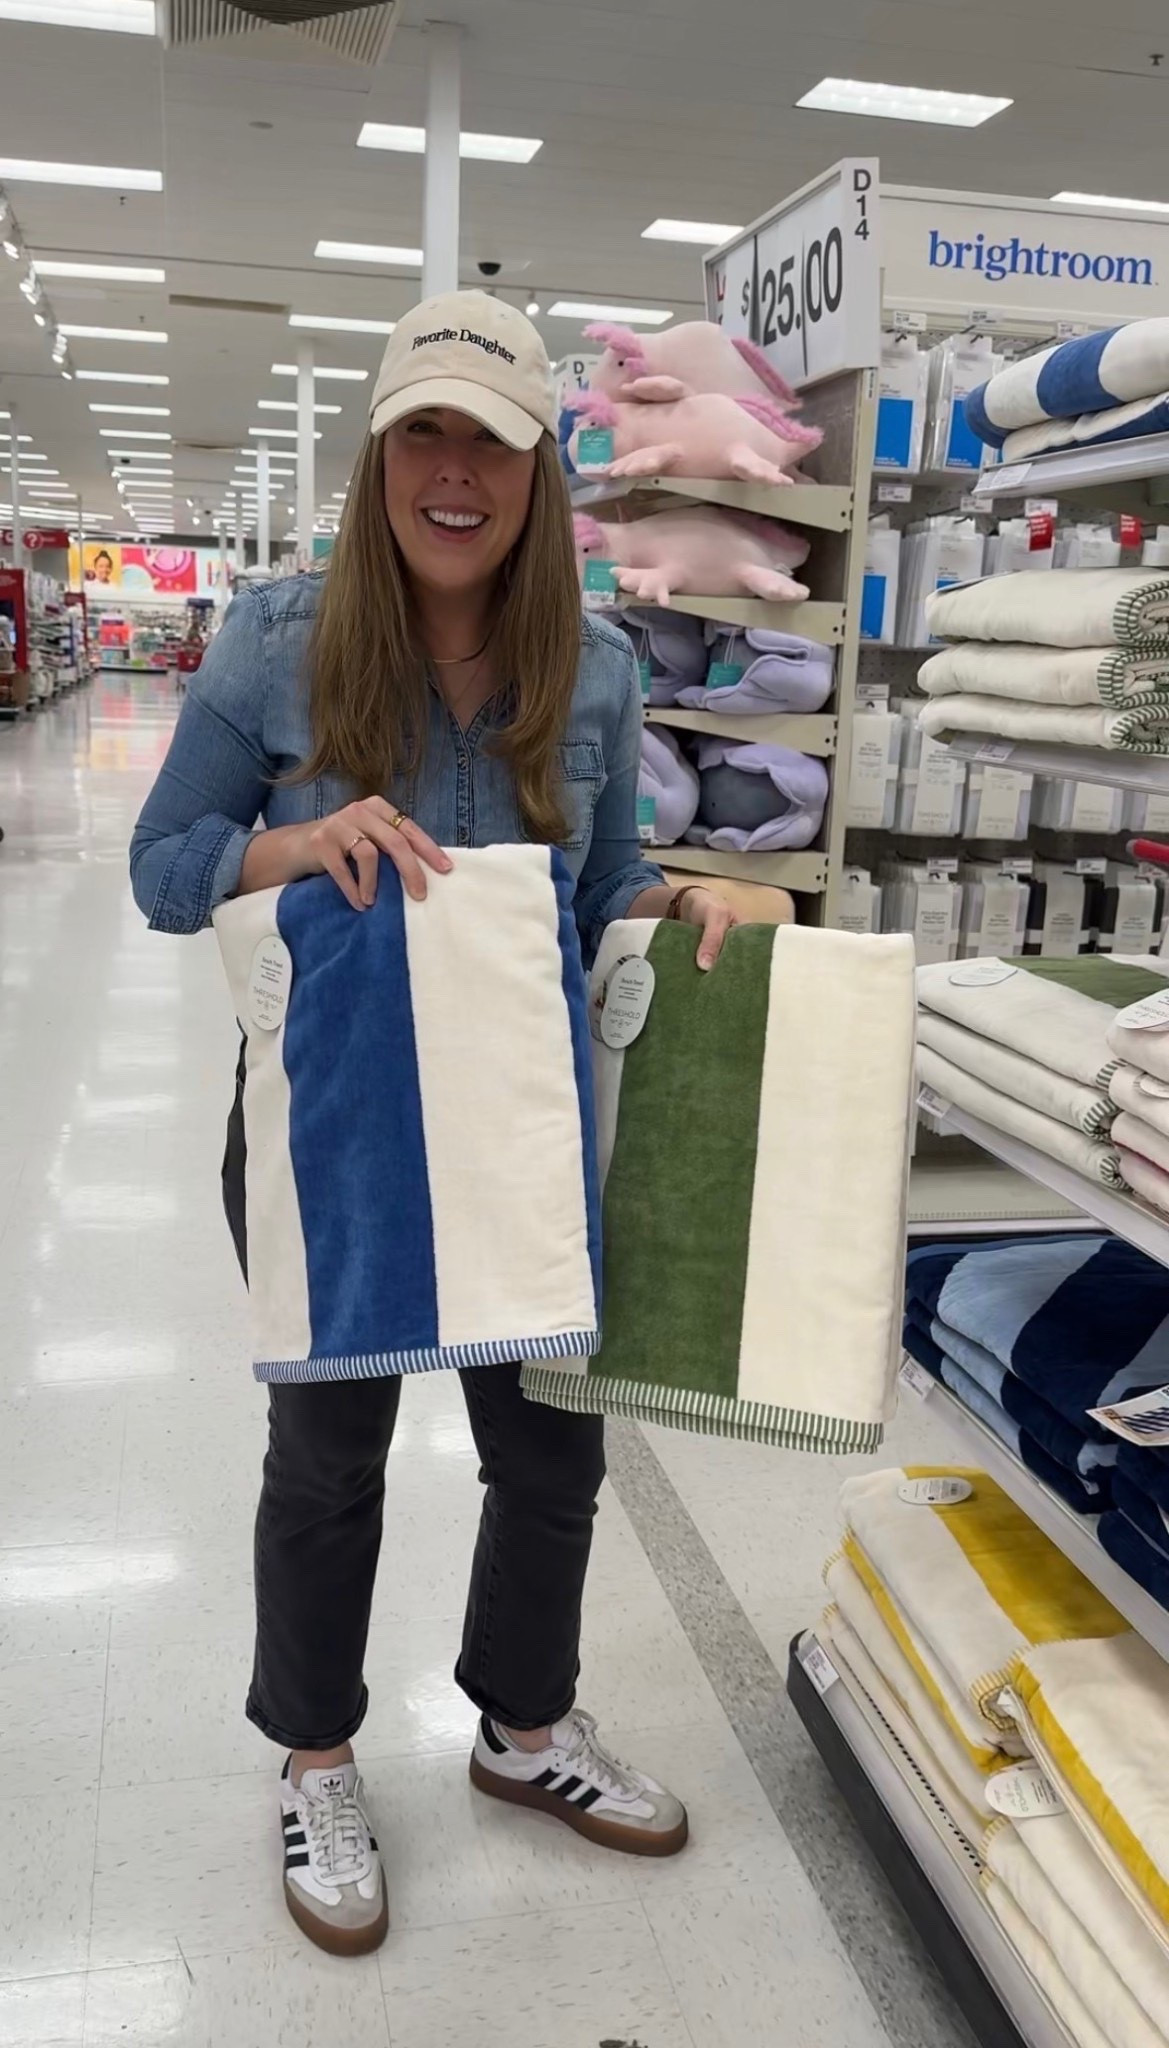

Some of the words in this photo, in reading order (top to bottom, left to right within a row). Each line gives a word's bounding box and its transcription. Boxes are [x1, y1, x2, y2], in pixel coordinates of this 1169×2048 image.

[929, 230, 1153, 285] brightroom
[411, 328, 457, 351] Favorite
[459, 329, 516, 365] Daughter
